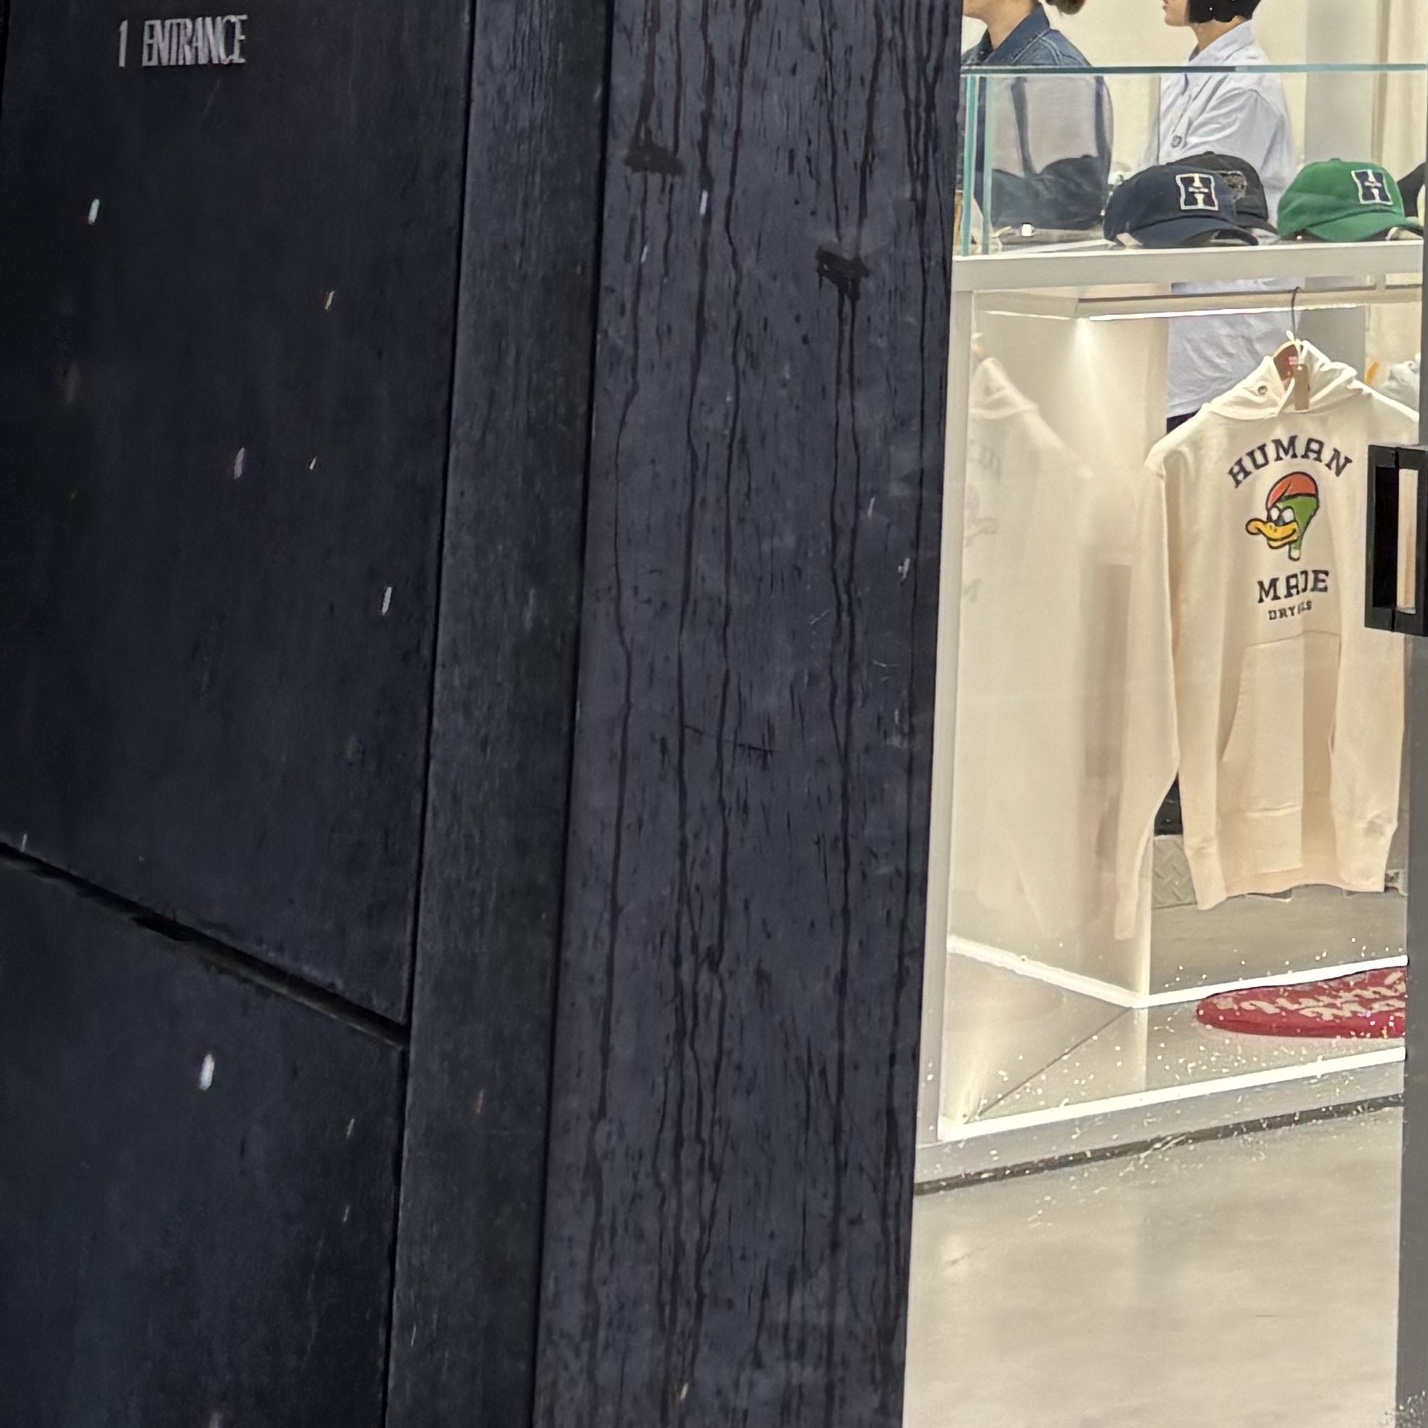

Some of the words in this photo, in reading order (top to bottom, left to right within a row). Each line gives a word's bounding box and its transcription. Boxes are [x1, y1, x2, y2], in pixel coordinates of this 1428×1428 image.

[118, 20, 128, 68] 1
[142, 14, 248, 67] ENTRANCE
[1228, 435, 1353, 488] HUMAN
